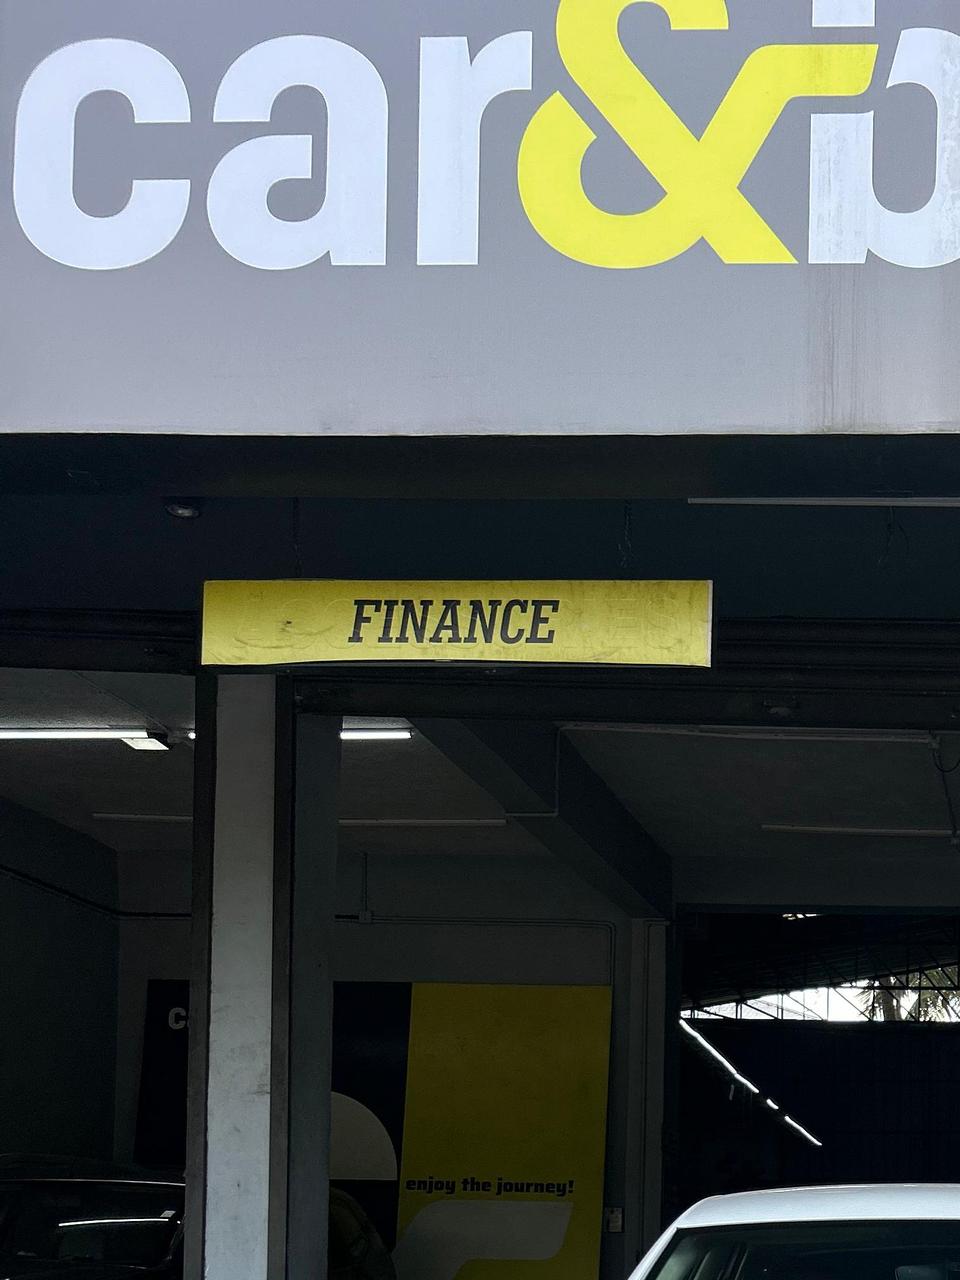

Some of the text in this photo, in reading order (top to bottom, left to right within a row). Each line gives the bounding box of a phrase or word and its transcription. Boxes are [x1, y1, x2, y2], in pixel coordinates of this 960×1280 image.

[348, 598, 560, 645] FINANCE
[405, 1175, 574, 1197] enjoy the journey!
